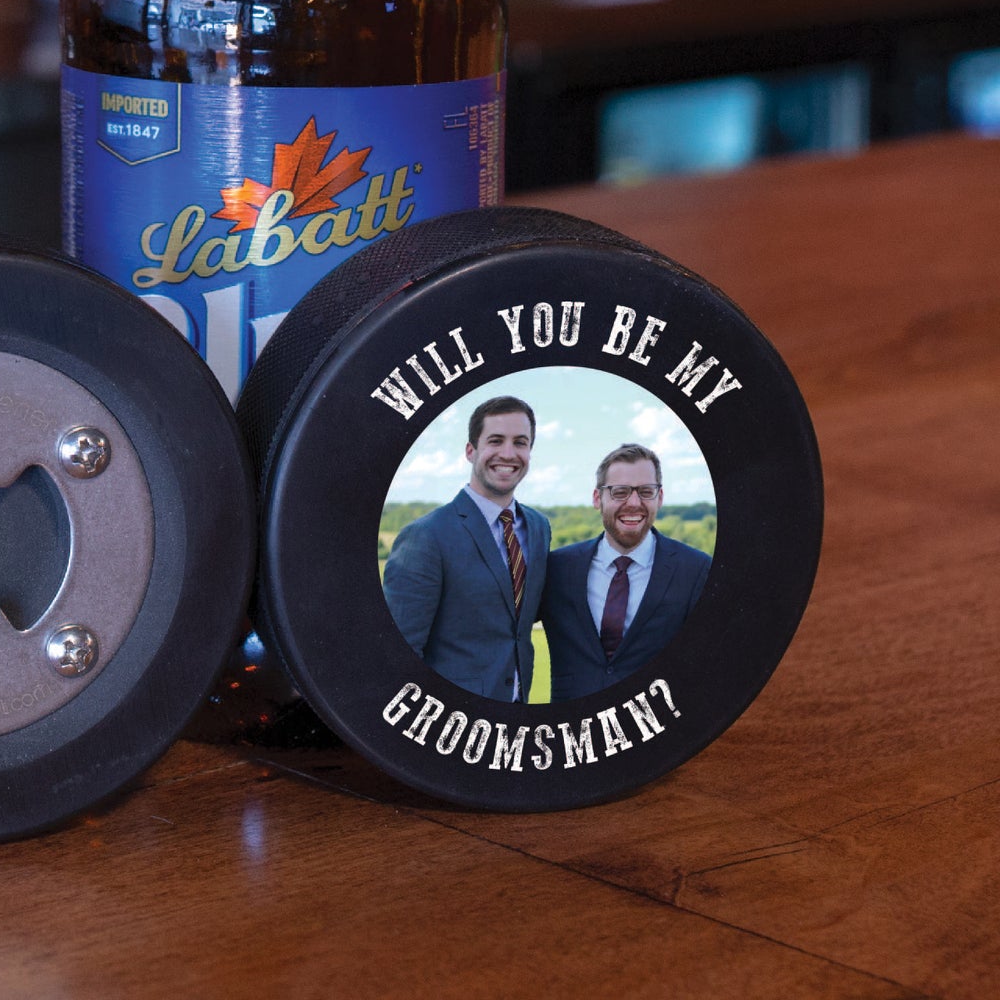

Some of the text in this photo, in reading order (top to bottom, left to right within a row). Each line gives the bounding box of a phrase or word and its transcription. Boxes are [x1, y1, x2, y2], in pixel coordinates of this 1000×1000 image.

[102, 92, 168, 118] IMPORTED
[370, 326, 485, 421] WILL
[497, 301, 585, 354] YOU
[602, 304, 667, 366] BE
[664, 340, 743, 414] MY
[382, 678, 683, 772] GROOMSMAN?
